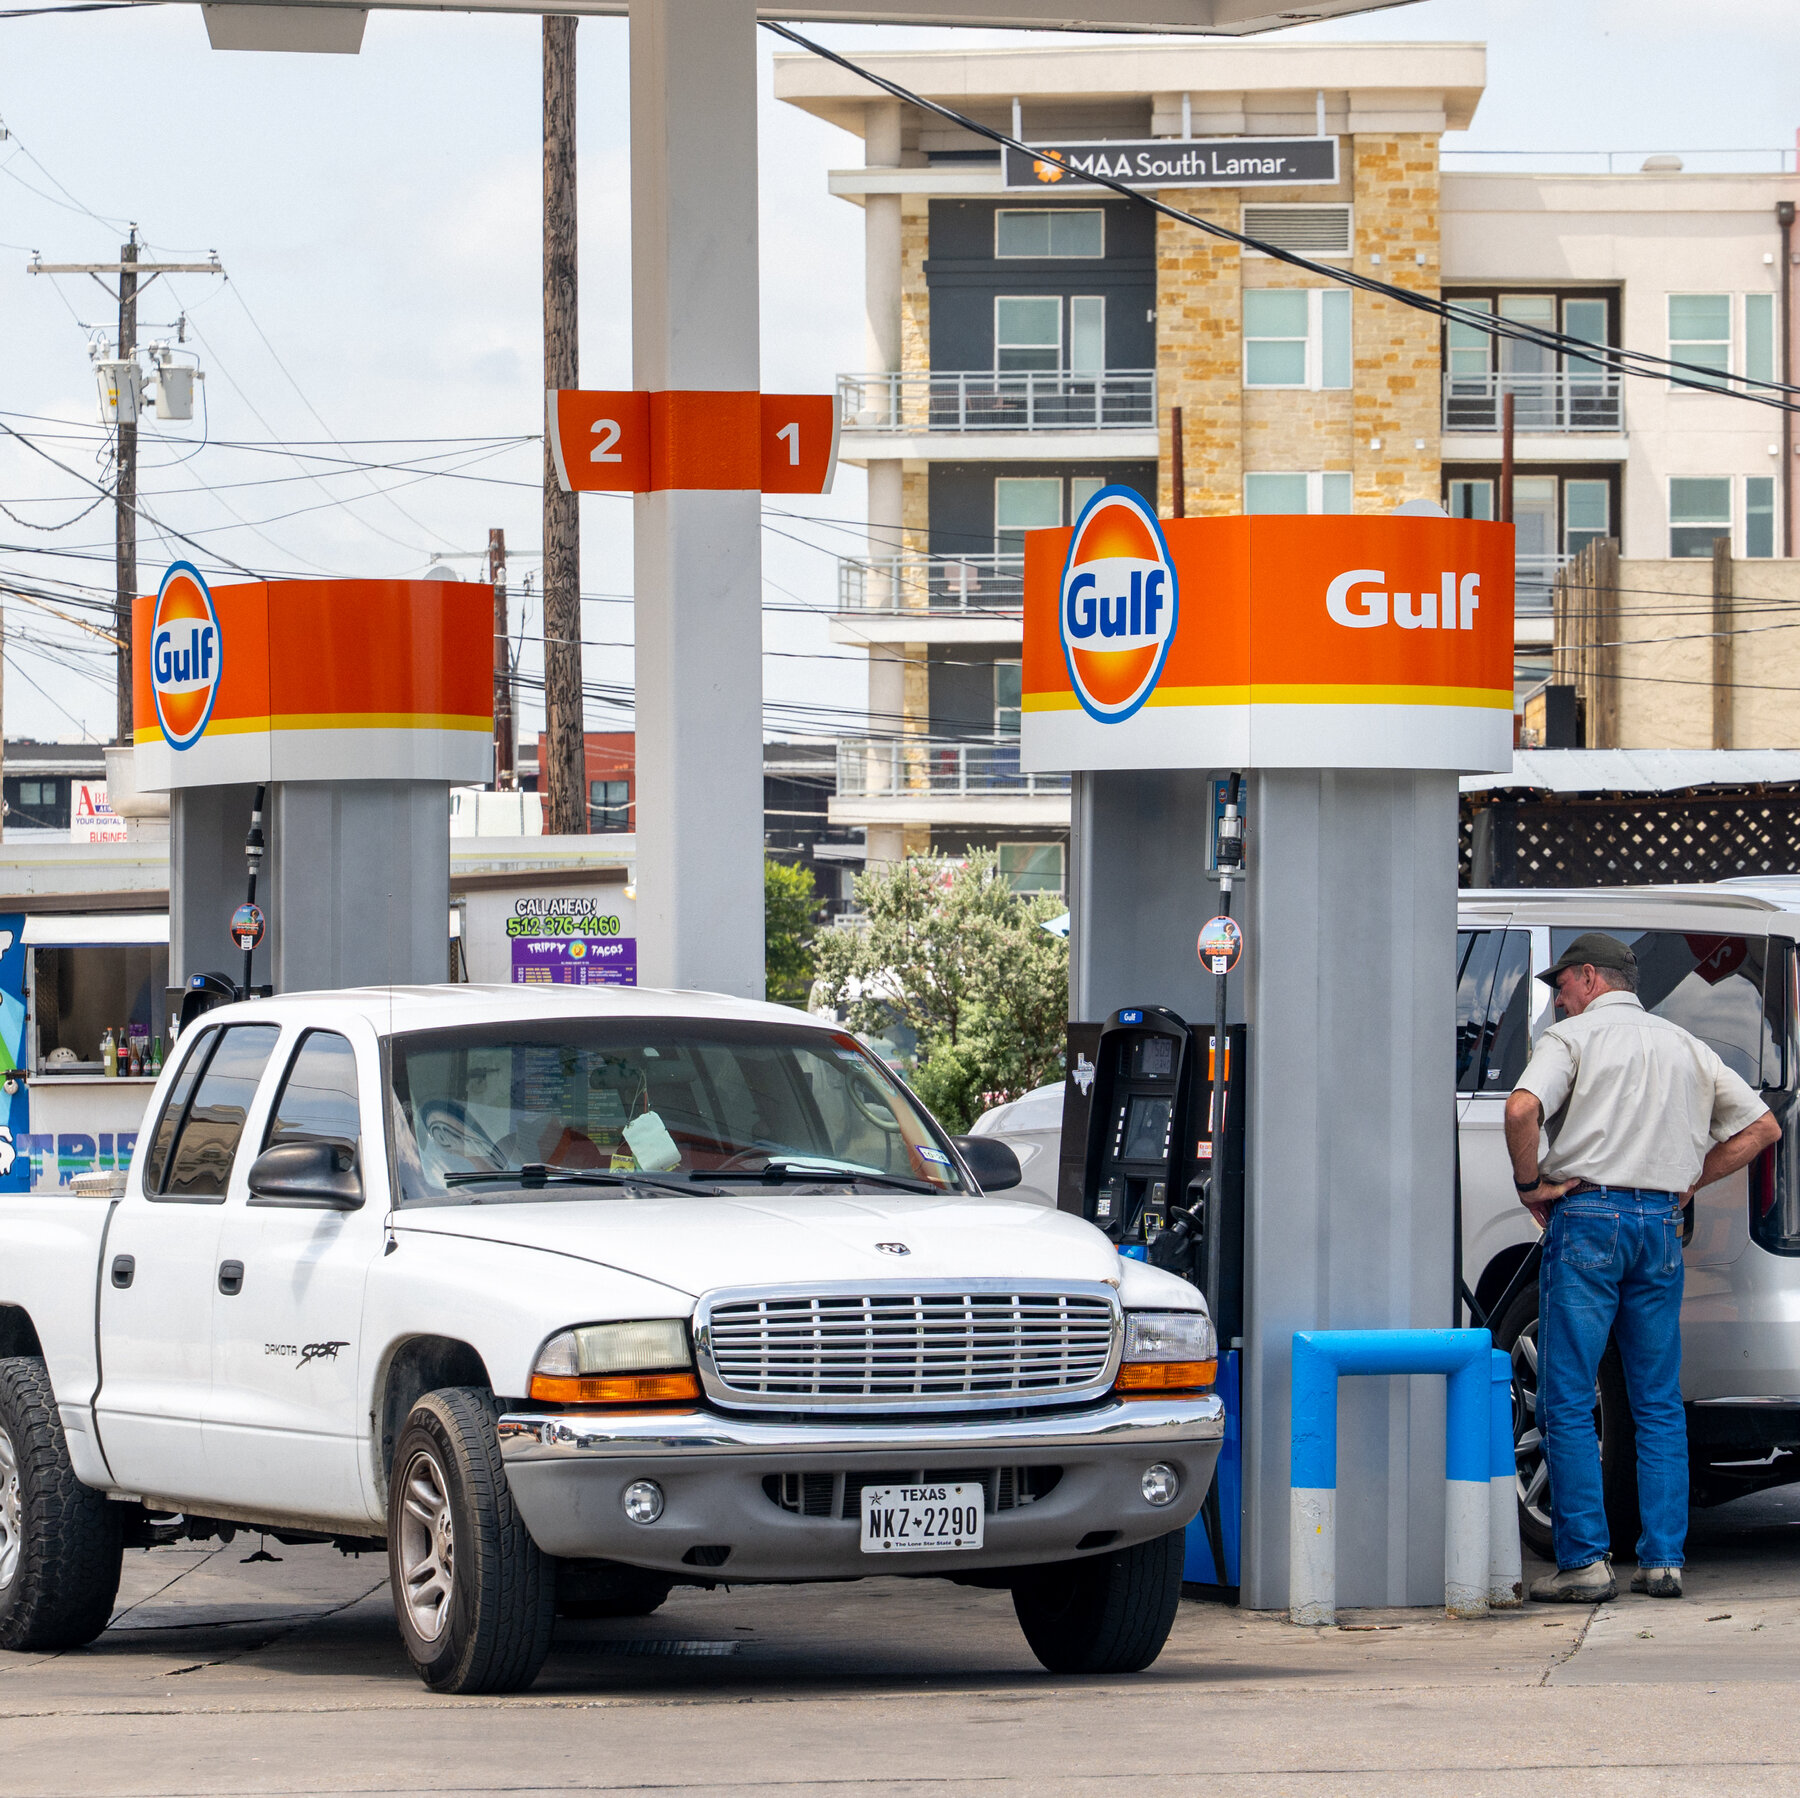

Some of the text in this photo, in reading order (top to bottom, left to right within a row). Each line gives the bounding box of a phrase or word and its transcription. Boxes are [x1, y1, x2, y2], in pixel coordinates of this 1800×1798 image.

[1069, 151, 1287, 178] MAA South Lamar
[589, 418, 623, 463] 2
[775, 422, 800, 466] 1
[1066, 569, 1166, 639] Gulf
[1325, 568, 1481, 631] Gulf
[154, 626, 214, 684] Gulf
[515, 898, 598, 916] CALL AHEAD!
[506, 916, 621, 937] 512-376-4460
[527, 942, 624, 957] TRIPPY TACOS
[1124, 1012, 1136, 1022] Gulf
[264, 1343, 298, 1356] DAKOTA
[900, 1488, 947, 1501] TEXAS
